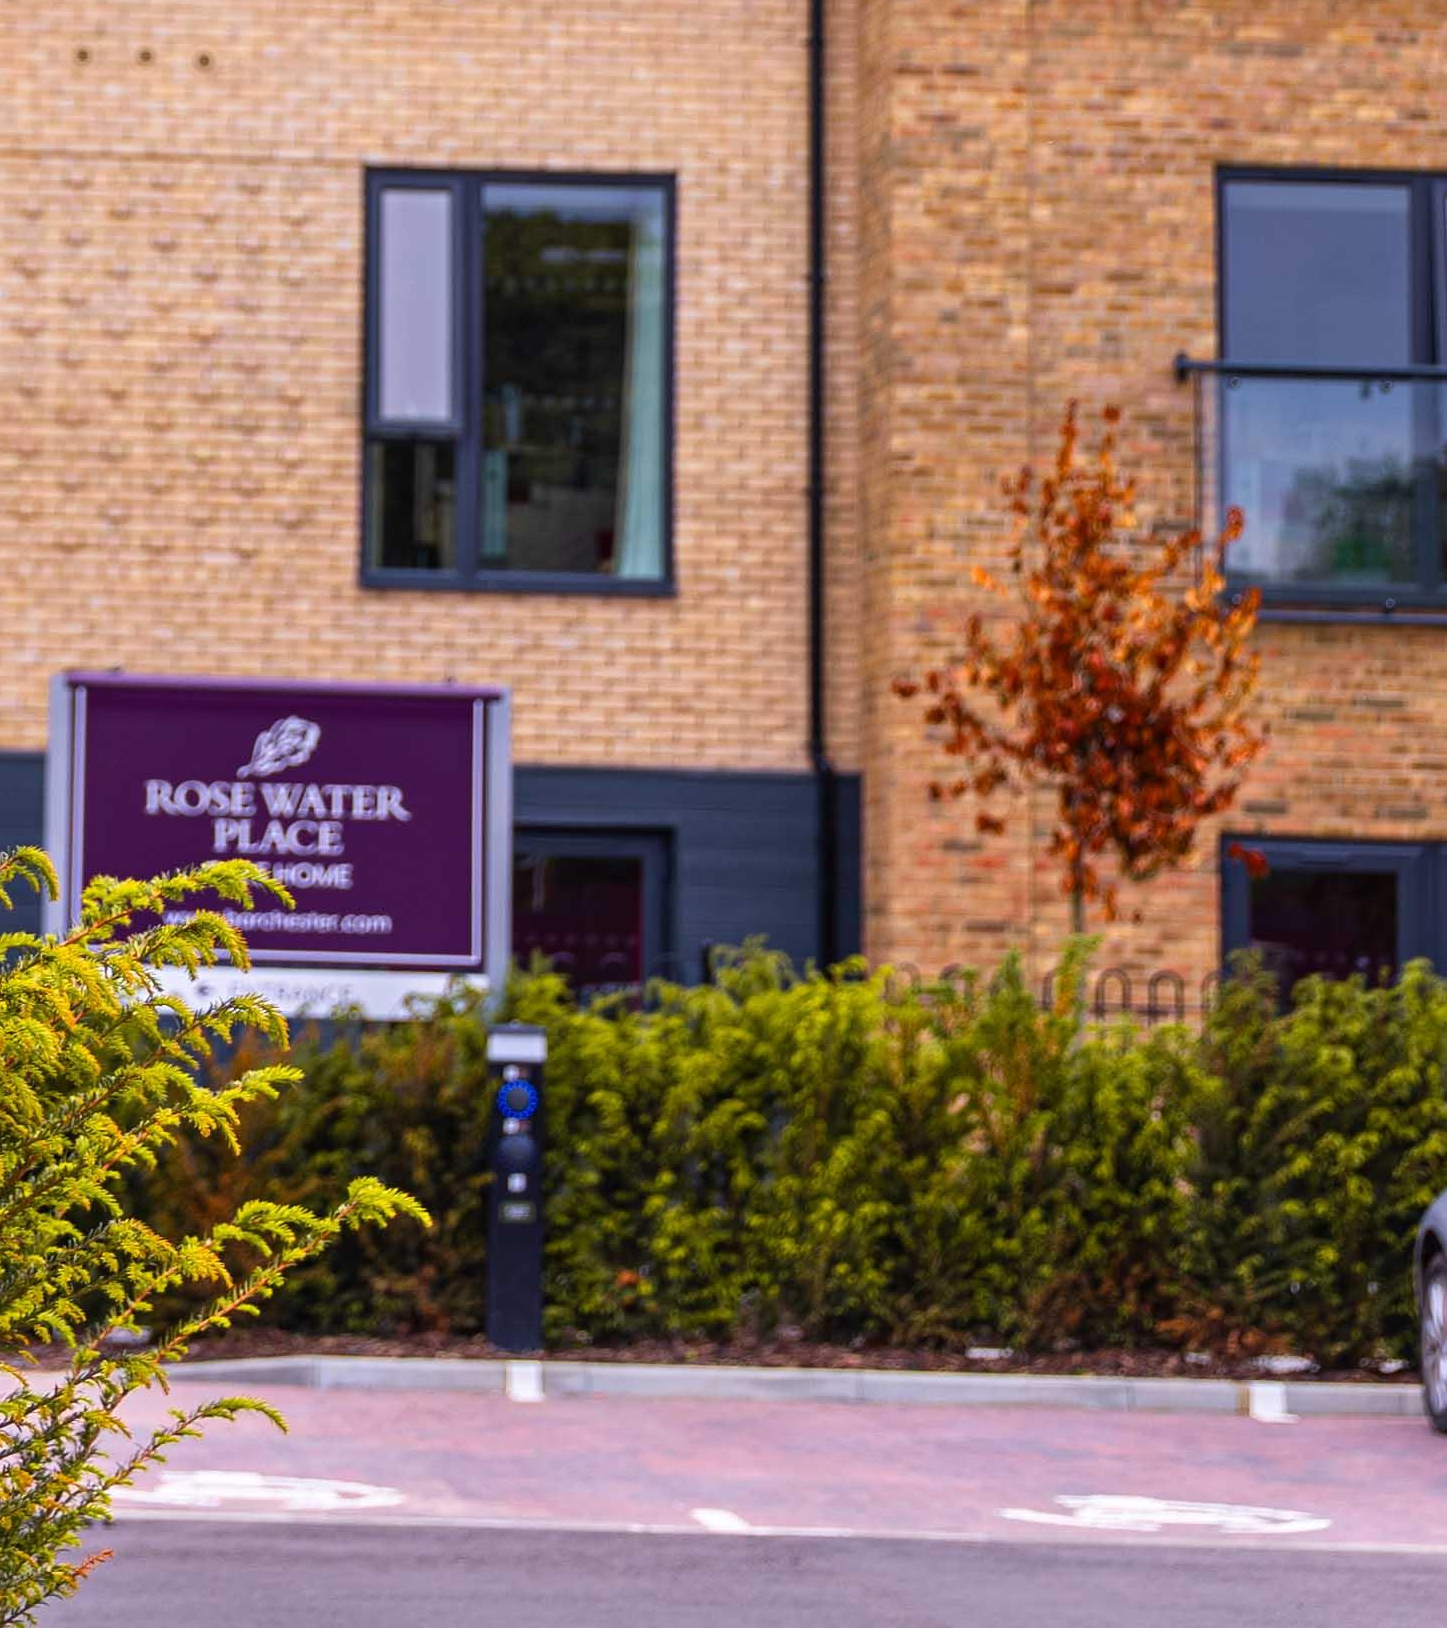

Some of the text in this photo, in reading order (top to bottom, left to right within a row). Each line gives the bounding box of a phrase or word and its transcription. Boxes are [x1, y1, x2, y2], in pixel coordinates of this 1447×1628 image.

[145, 779, 411, 821] ROSE WATER
[213, 819, 345, 856] PLACE
[272, 861, 354, 890] HOME
